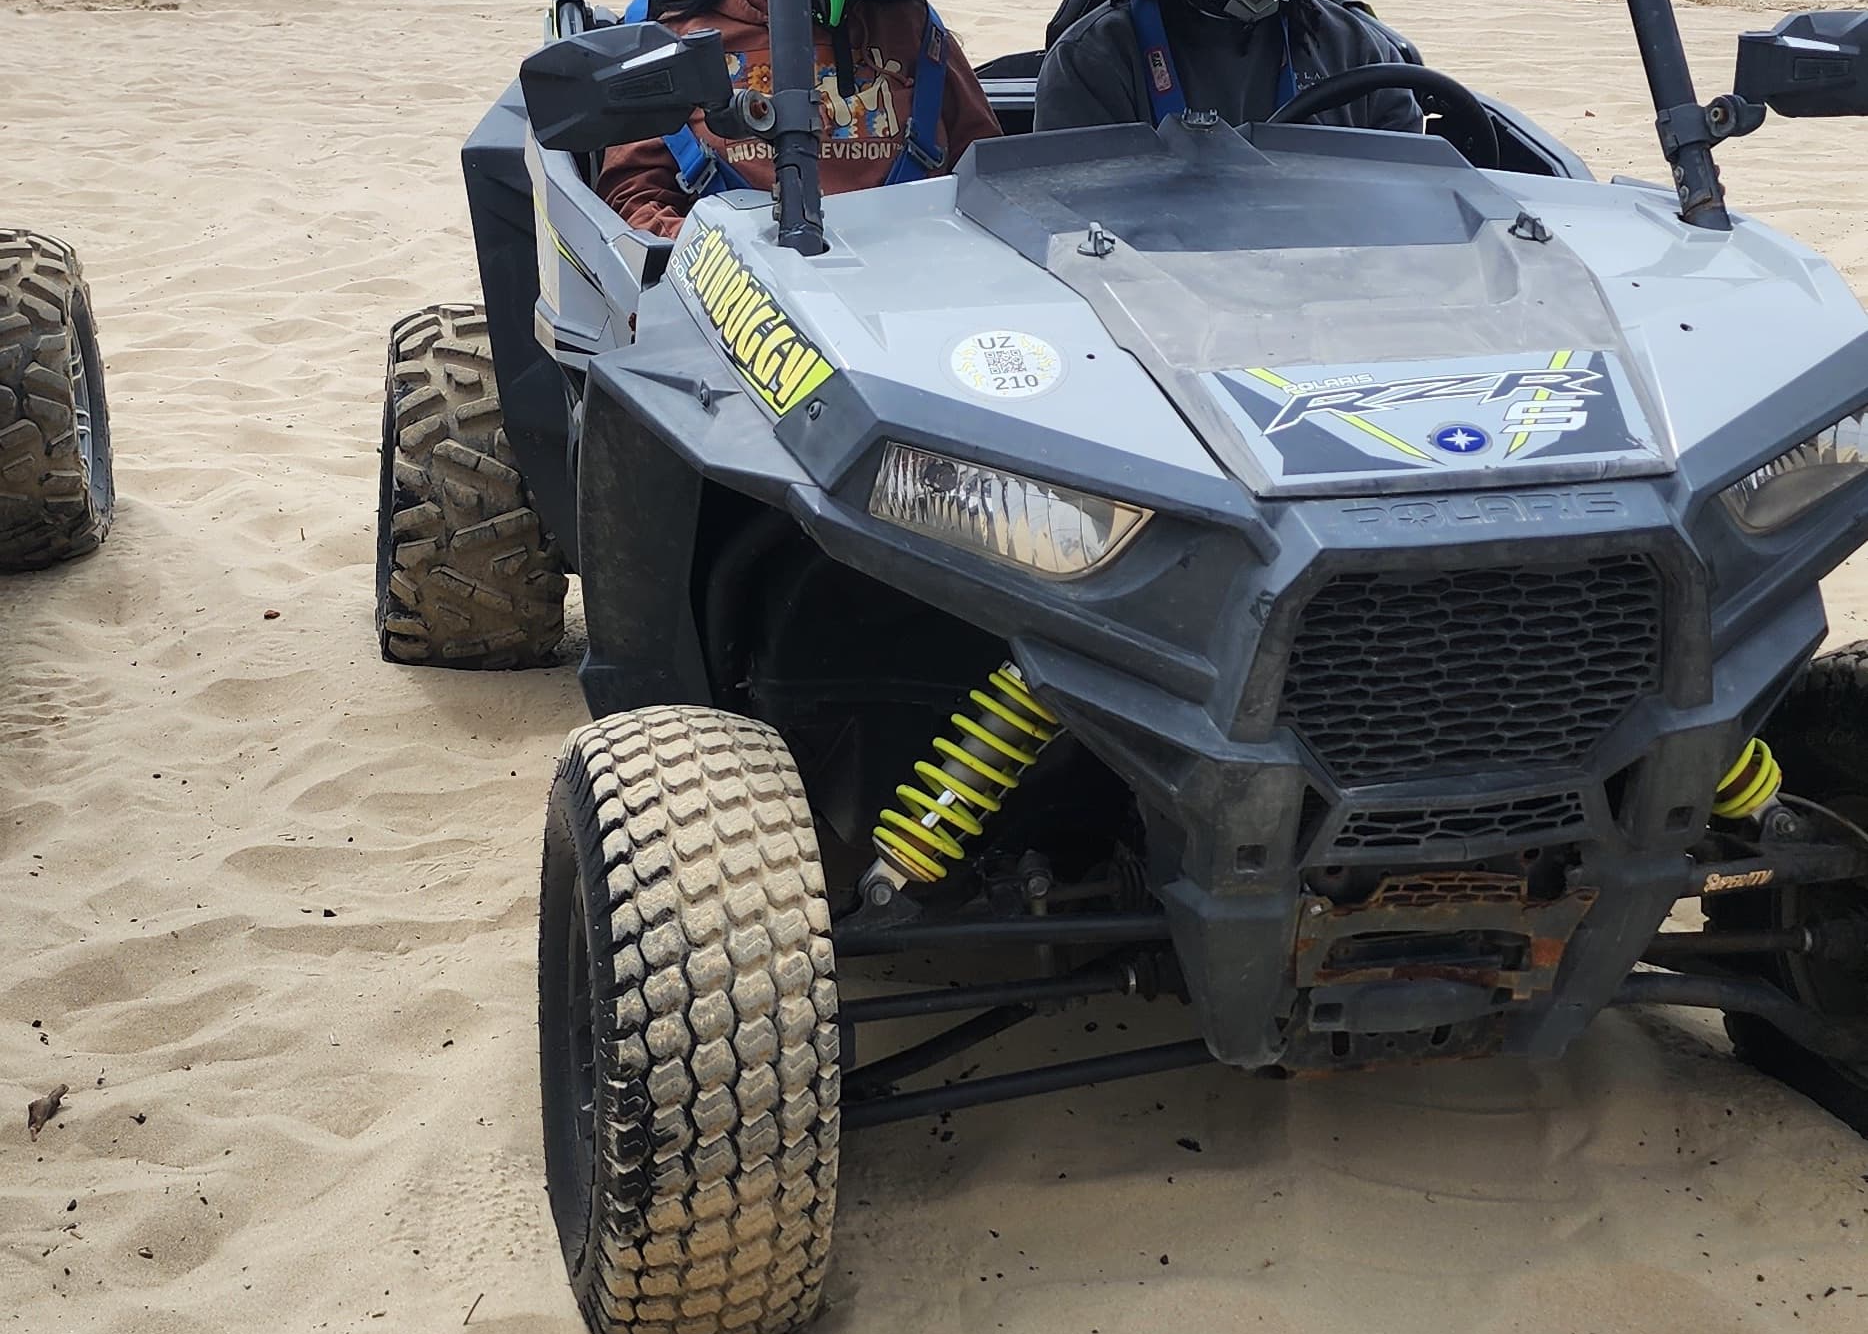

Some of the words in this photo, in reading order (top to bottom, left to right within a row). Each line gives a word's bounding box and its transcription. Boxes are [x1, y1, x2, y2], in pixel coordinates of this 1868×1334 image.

[727, 140, 776, 164] MUSI
[687, 225, 822, 408] SUNBUGGY
[977, 335, 1016, 350] UZ
[992, 373, 1039, 391] 210
[1282, 372, 1375, 395] POLARIS
[1261, 368, 1604, 436] RZR
[1340, 491, 1630, 529] POLARIS
